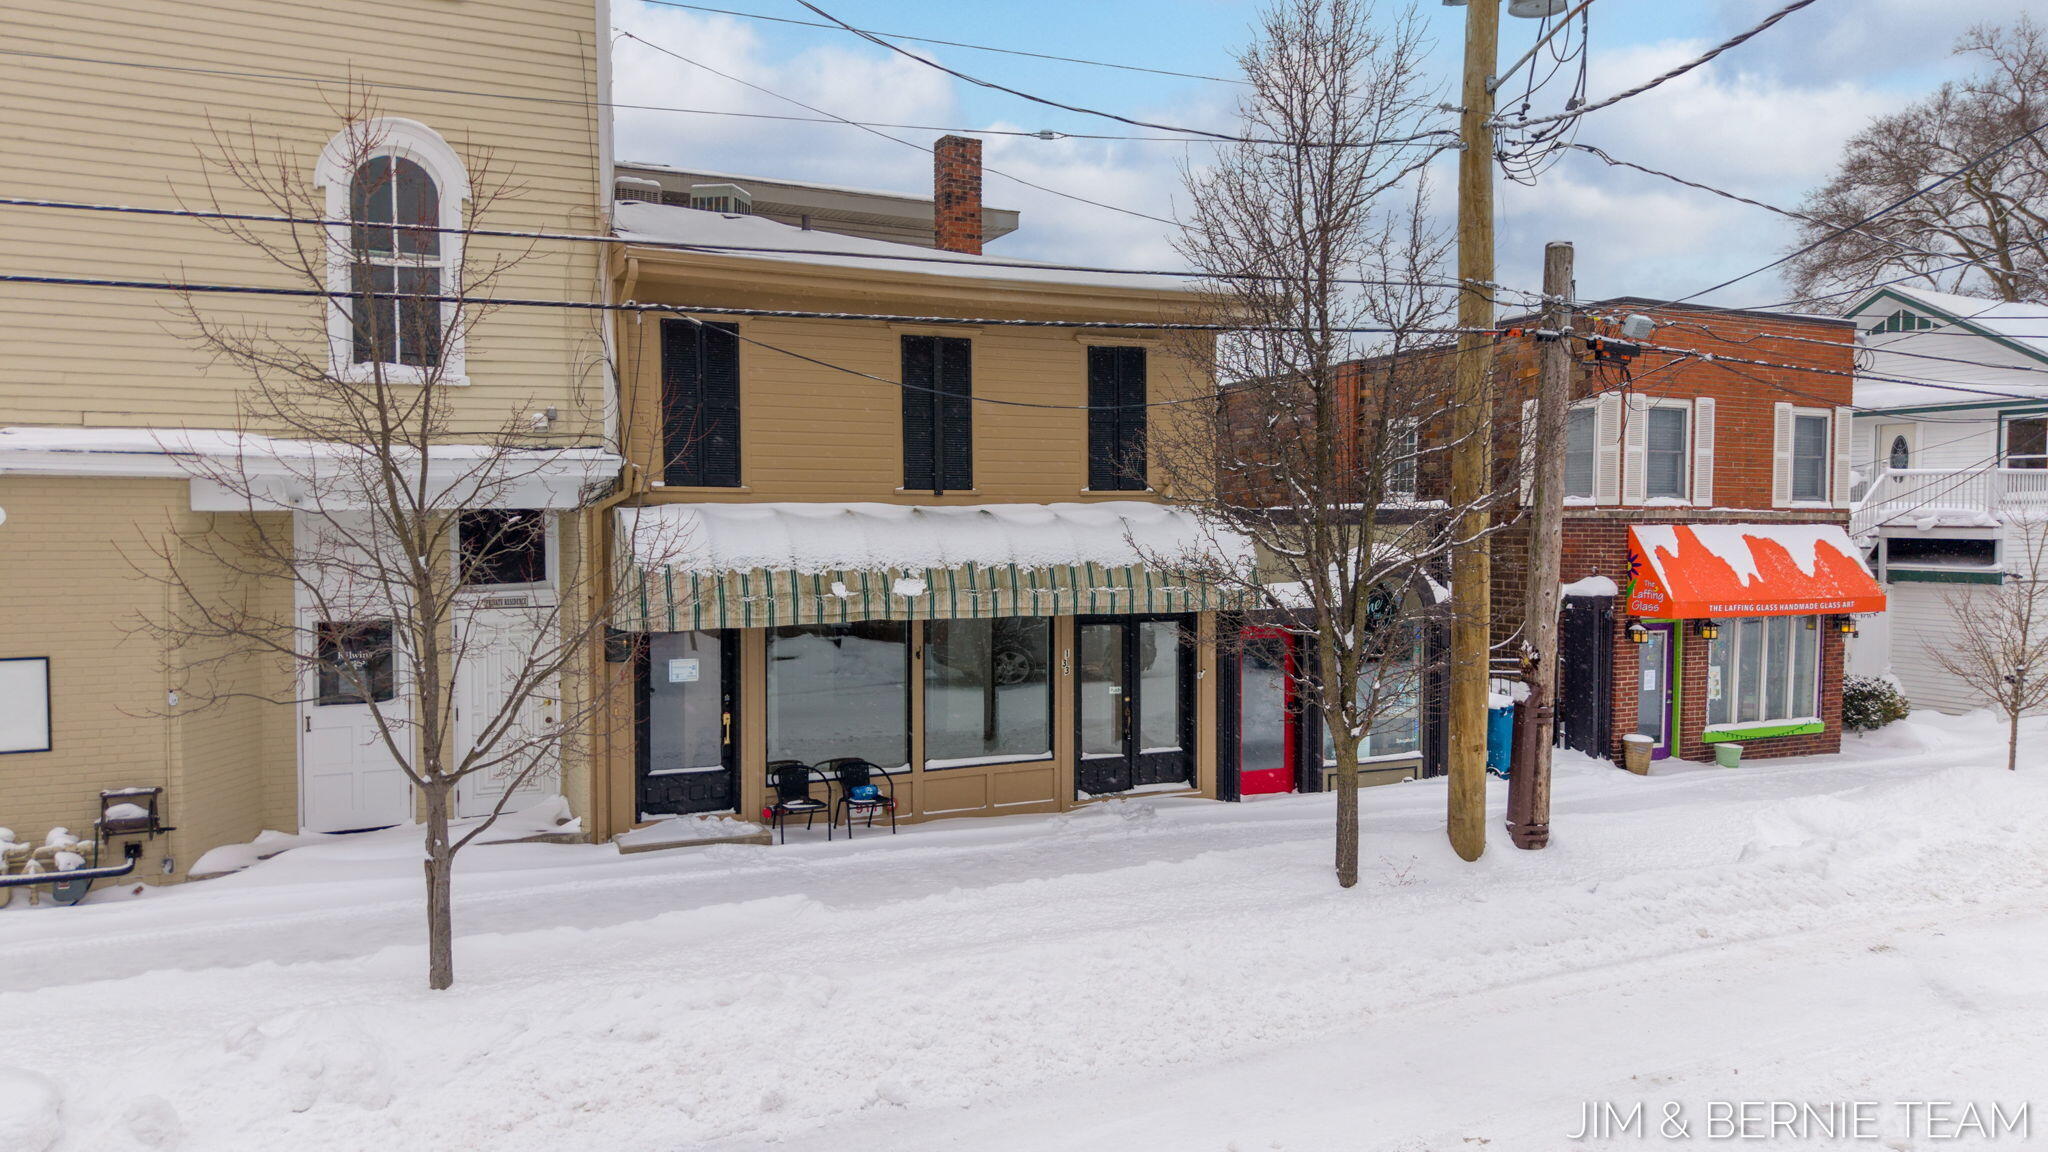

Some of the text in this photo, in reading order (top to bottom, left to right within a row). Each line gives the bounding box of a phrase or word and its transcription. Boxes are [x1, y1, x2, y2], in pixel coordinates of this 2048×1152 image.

[1633, 588, 1664, 603] Laffing
[504, 598, 527, 606] RESIDENCE
[1632, 600, 1659, 612] Glass
[1725, 604, 1754, 612] LAFFING
[1756, 603, 1778, 611] GLASS
[1779, 602, 1818, 611] HANDMADE
[1820, 601, 1841, 609] GLASS
[1062, 648, 1070, 676] 133
